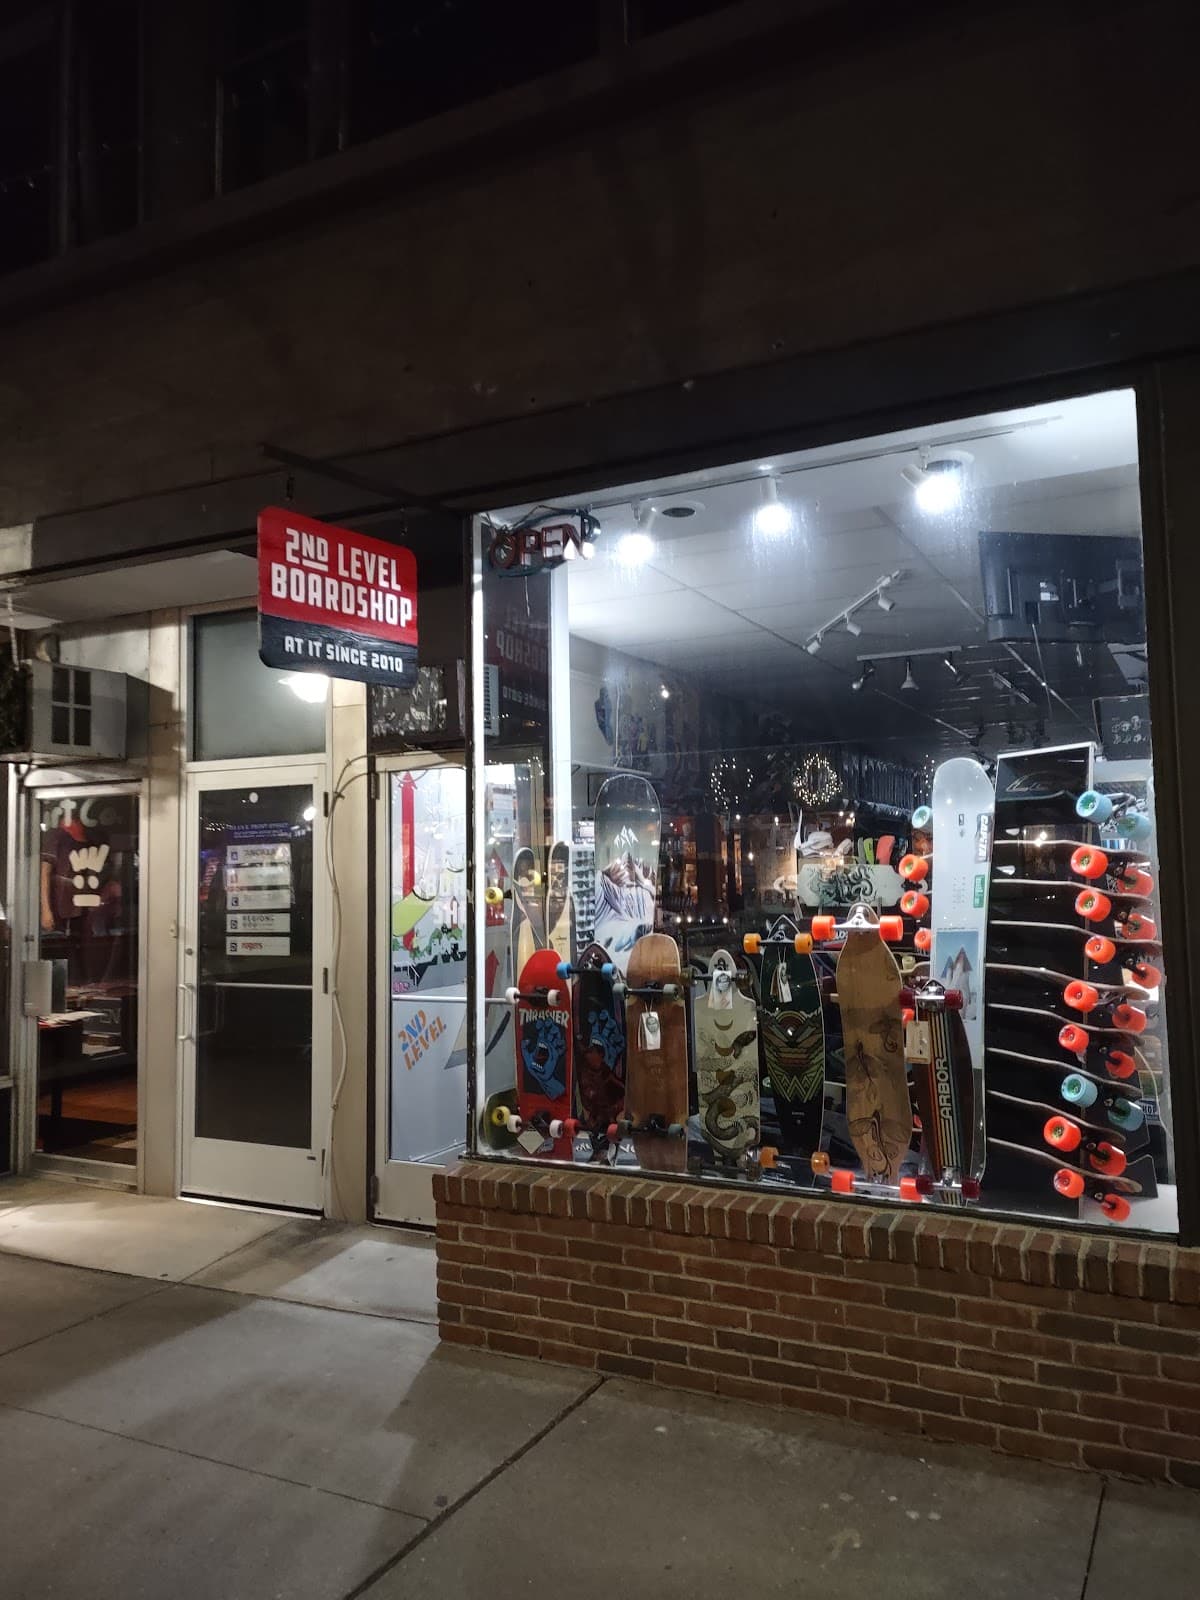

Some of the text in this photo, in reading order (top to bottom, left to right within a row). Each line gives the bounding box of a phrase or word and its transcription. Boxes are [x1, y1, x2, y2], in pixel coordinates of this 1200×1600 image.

[286, 528, 401, 592] 2ND LEVEL
[490, 519, 586, 569] OPEN
[271, 562, 412, 628] BOARDSHOP
[284, 635, 403, 673] AT IT SINCE 2010
[398, 1009, 427, 1053] 2ND
[404, 1016, 447, 1071] LEVEL
[518, 1007, 570, 1029] THRASHER
[935, 1057, 953, 1120] ARBOR
